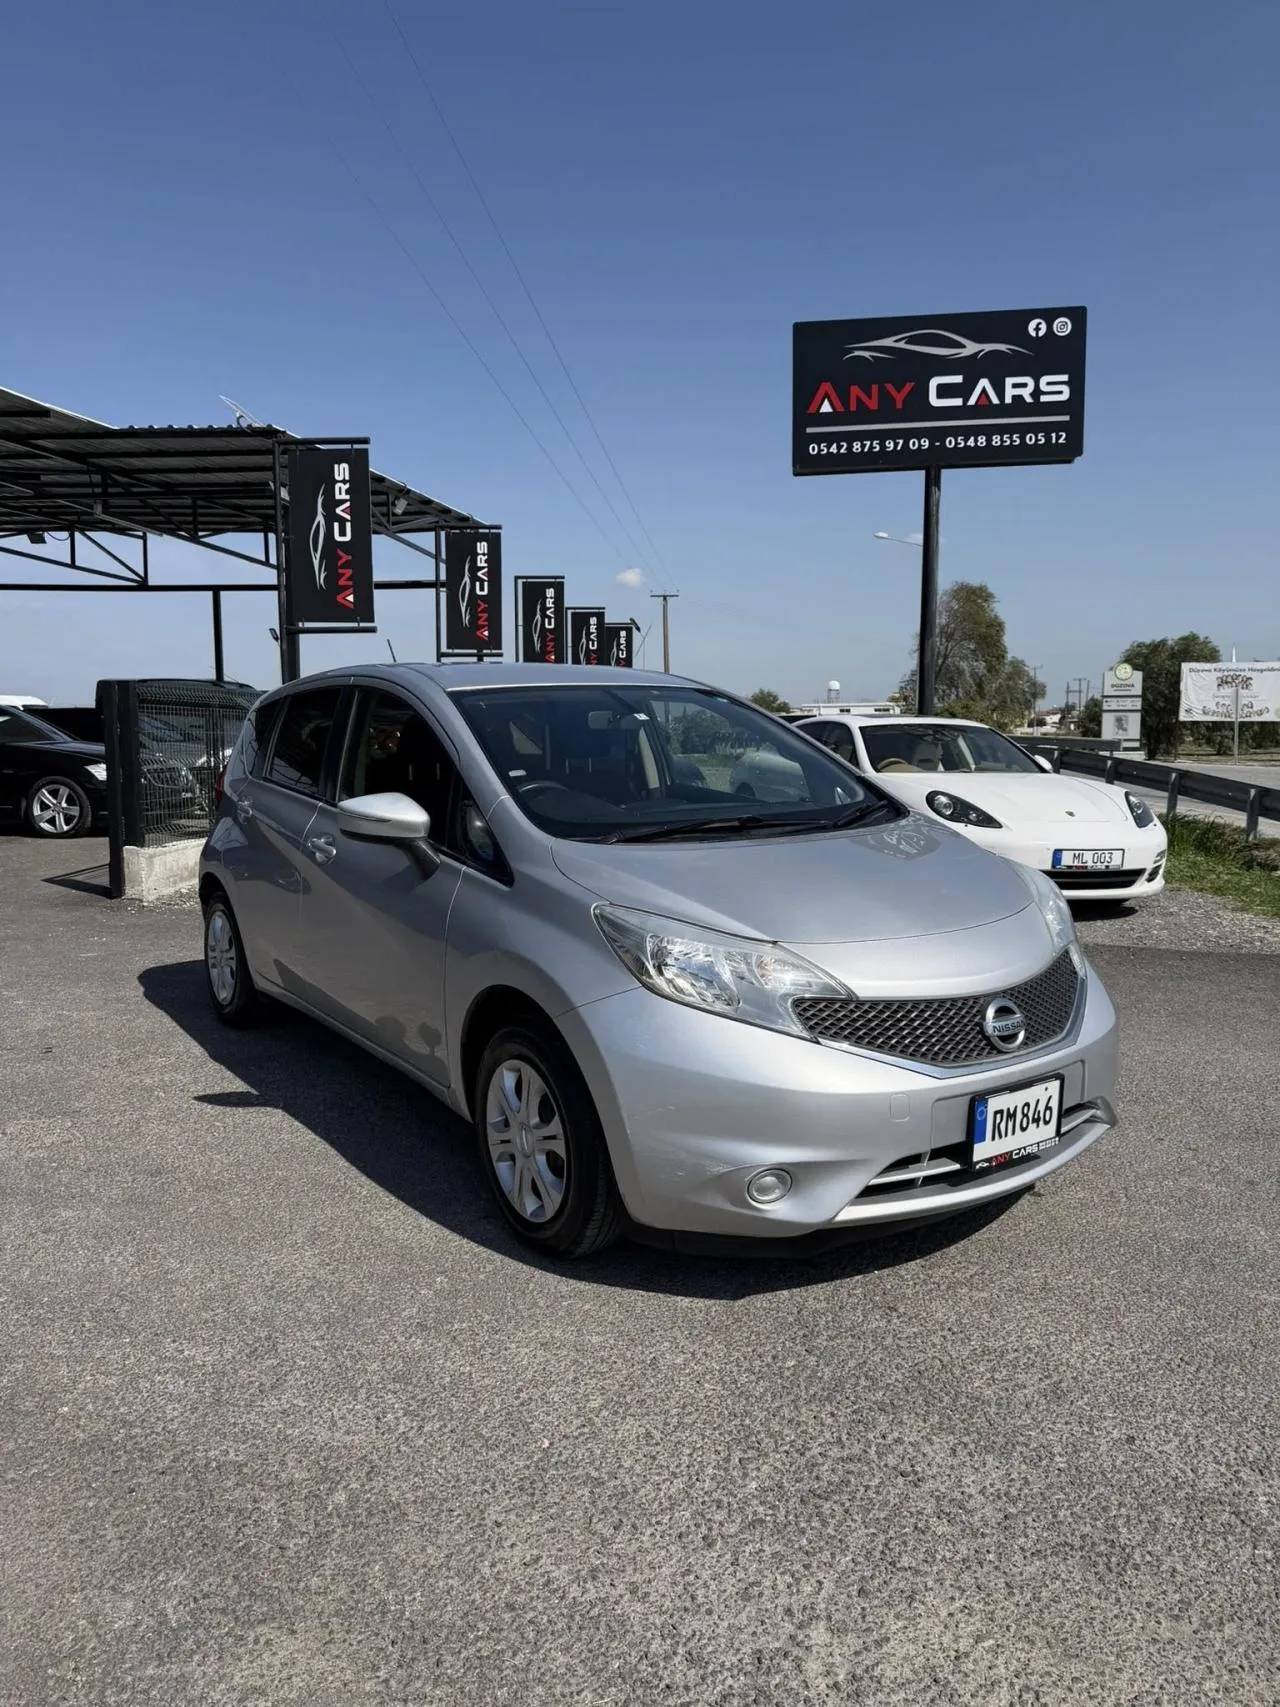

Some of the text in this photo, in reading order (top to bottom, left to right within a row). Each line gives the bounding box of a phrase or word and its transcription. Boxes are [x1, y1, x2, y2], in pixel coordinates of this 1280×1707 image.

[807, 374, 1070, 413] ANY CARS
[809, 442, 848, 455] 0542
[852, 440, 880, 453] 875
[885, 439, 903, 451] 97
[909, 438, 929, 451] 09
[946, 436, 986, 449] 0548
[992, 434, 1020, 447] 855
[1026, 433, 1045, 445] 05
[1051, 432, 1066, 444] 12
[334, 462, 354, 609] ANY CARS
[476, 541, 489, 640] ANY CARS
[545, 588, 555, 663] ANY CARS
[589, 616, 597, 650] CARS
[1072, 852, 1113, 864] ML 003
[990, 1152, 1010, 1168] ANY
[1012, 1143, 1039, 1159] CARS
